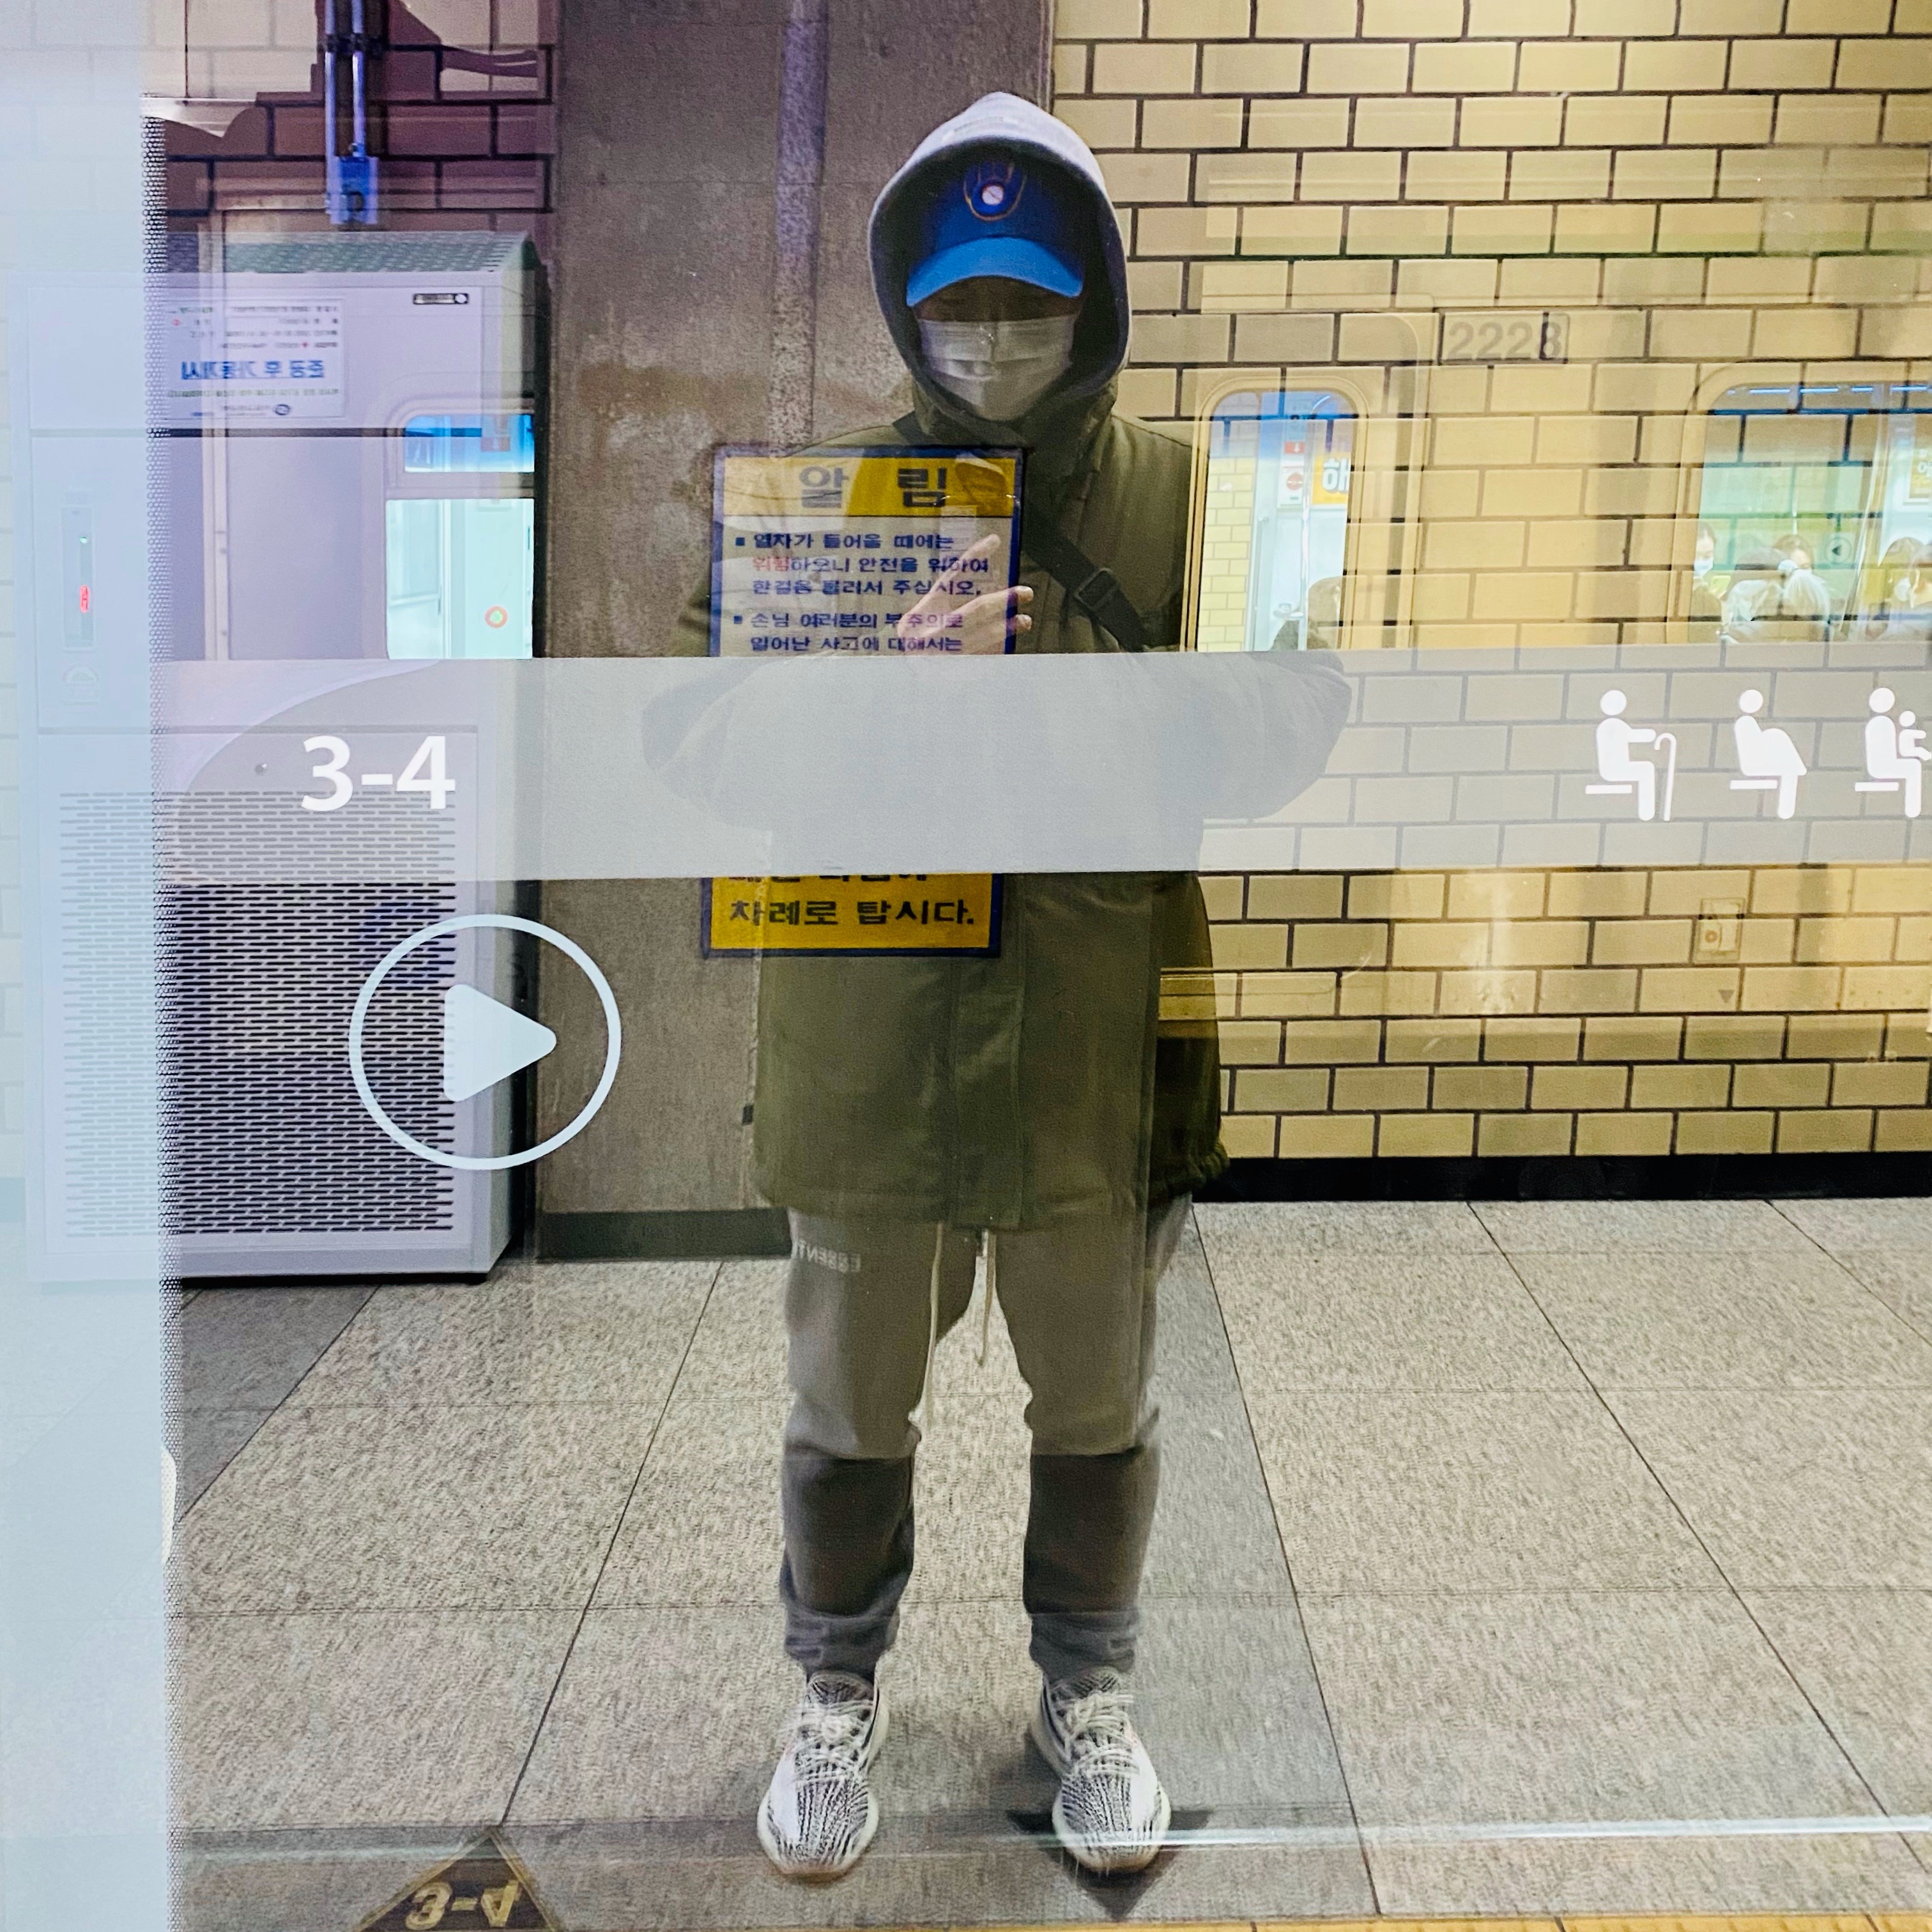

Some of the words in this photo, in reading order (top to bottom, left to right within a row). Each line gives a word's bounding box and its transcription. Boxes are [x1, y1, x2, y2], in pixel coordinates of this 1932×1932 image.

[753, 533, 814, 549] 열차가
[894, 534, 954, 549] 때에는
[753, 556, 850, 572] 위험하오니
[859, 557, 918, 572] 안전을
[928, 556, 988, 572] 위하여
[753, 579, 811, 595] 한걸음
[751, 613, 789, 628] 손님
[800, 613, 878, 628] 여러분의
[884, 613, 963, 628] 부주의로
[751, 636, 811, 652] 일어난
[820, 636, 880, 652] 사고에
[887, 636, 963, 652] 대해서는
[300, 735, 456, 812] 3-4
[730, 900, 839, 926] 차례로
[856, 900, 975, 925] 탑시다.
